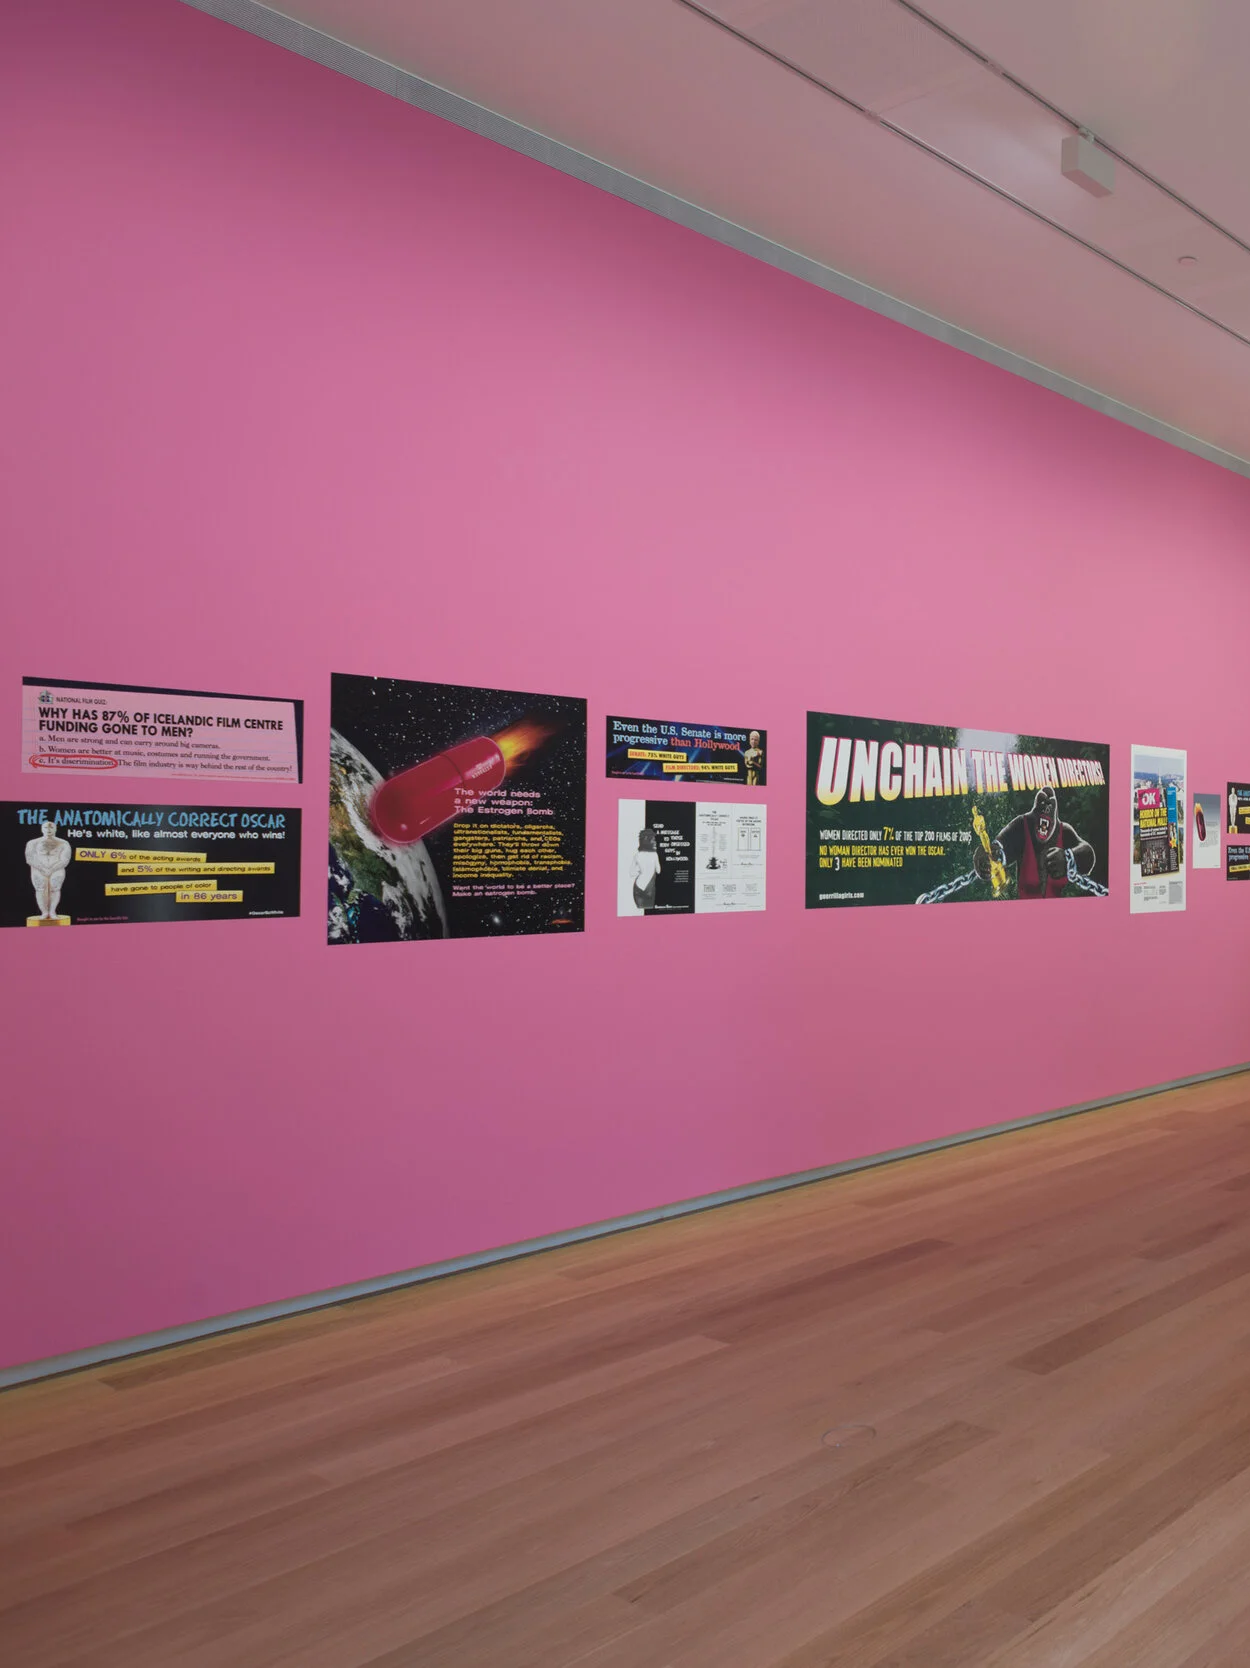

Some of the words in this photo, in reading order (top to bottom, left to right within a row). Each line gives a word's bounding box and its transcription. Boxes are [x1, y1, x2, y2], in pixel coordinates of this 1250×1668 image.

[38, 706, 68, 719] WHY
[72, 708, 98, 720] HAS
[102, 710, 130, 724] 87%
[134, 712, 150, 724] OF
[154, 714, 214, 727] ICELANDIC
[216, 717, 240, 728] FILM
[244, 718, 284, 730] CENTRE
[39, 720, 98, 734] FUNDING
[102, 723, 138, 735] GONE
[142, 725, 158, 736] TO
[161, 726, 194, 738] MEN?
[613, 721, 638, 732] Even
[642, 722, 657, 734] the
[660, 724, 678, 736] U.S.
[681, 726, 711, 738] Senate
[714, 730, 722, 740] is
[724, 732, 746, 741] more
[48, 734, 66, 742] Men
[80, 737, 104, 745] strong
[613, 734, 668, 746] progressive
[670, 736, 691, 746] than
[694, 737, 740, 751] Hollywood
[48, 746, 76, 754] Women
[148, 760, 176, 768] industry
[200, 762, 222, 770] behind
[815, 736, 969, 806] UNCHAIN
[970, 749, 1008, 794] THE
[1006, 752, 1060, 791] WOMEN
[454, 788, 474, 796] The
[510, 790, 541, 798] needs
[491, 799, 533, 807] weapon:
[454, 806, 474, 814] The
[478, 806, 523, 816] Estrogen
[526, 808, 554, 816] Bomb
[17, 808, 48, 825] THE
[54, 809, 164, 828] ANATOMICALLY
[168, 812, 238, 828] CORRECT
[241, 813, 286, 829] OSCAR
[67, 829, 92, 838] He's
[96, 830, 128, 840] white,
[132, 830, 150, 838] like
[153, 830, 188, 839] almost
[191, 831, 236, 840] everyone
[262, 831, 286, 840] wins!
[820, 830, 840, 840] WOMEN
[842, 830, 868, 840] DIRECTED
[869, 830, 882, 840] ONLY
[883, 826, 894, 841] 7%
[895, 831, 902, 841] OF
[904, 831, 914, 842] THE
[914, 831, 924, 842] TOP
[924, 830, 935, 842] 200
[936, 832, 952, 842] FILMS
[952, 832, 958, 842] OF
[80, 850, 106, 858] ONLY
[110, 851, 126, 859] 6%
[819, 846, 827, 856] NO
[829, 846, 850, 856] WOMAN
[851, 846, 877, 856] DIRECTOR
[878, 846, 890, 856] HAS
[890, 846, 904, 856] EVER
[917, 846, 927, 856] THE
[819, 858, 834, 868] ONLY
[834, 857, 840, 870] 3
[841, 858, 856, 868] HAVE
[858, 858, 872, 867] BEEN
[872, 856, 904, 868] NOMINATED
[180, 892, 190, 900] in
[194, 892, 208, 900] 86
[210, 892, 238, 901] years
